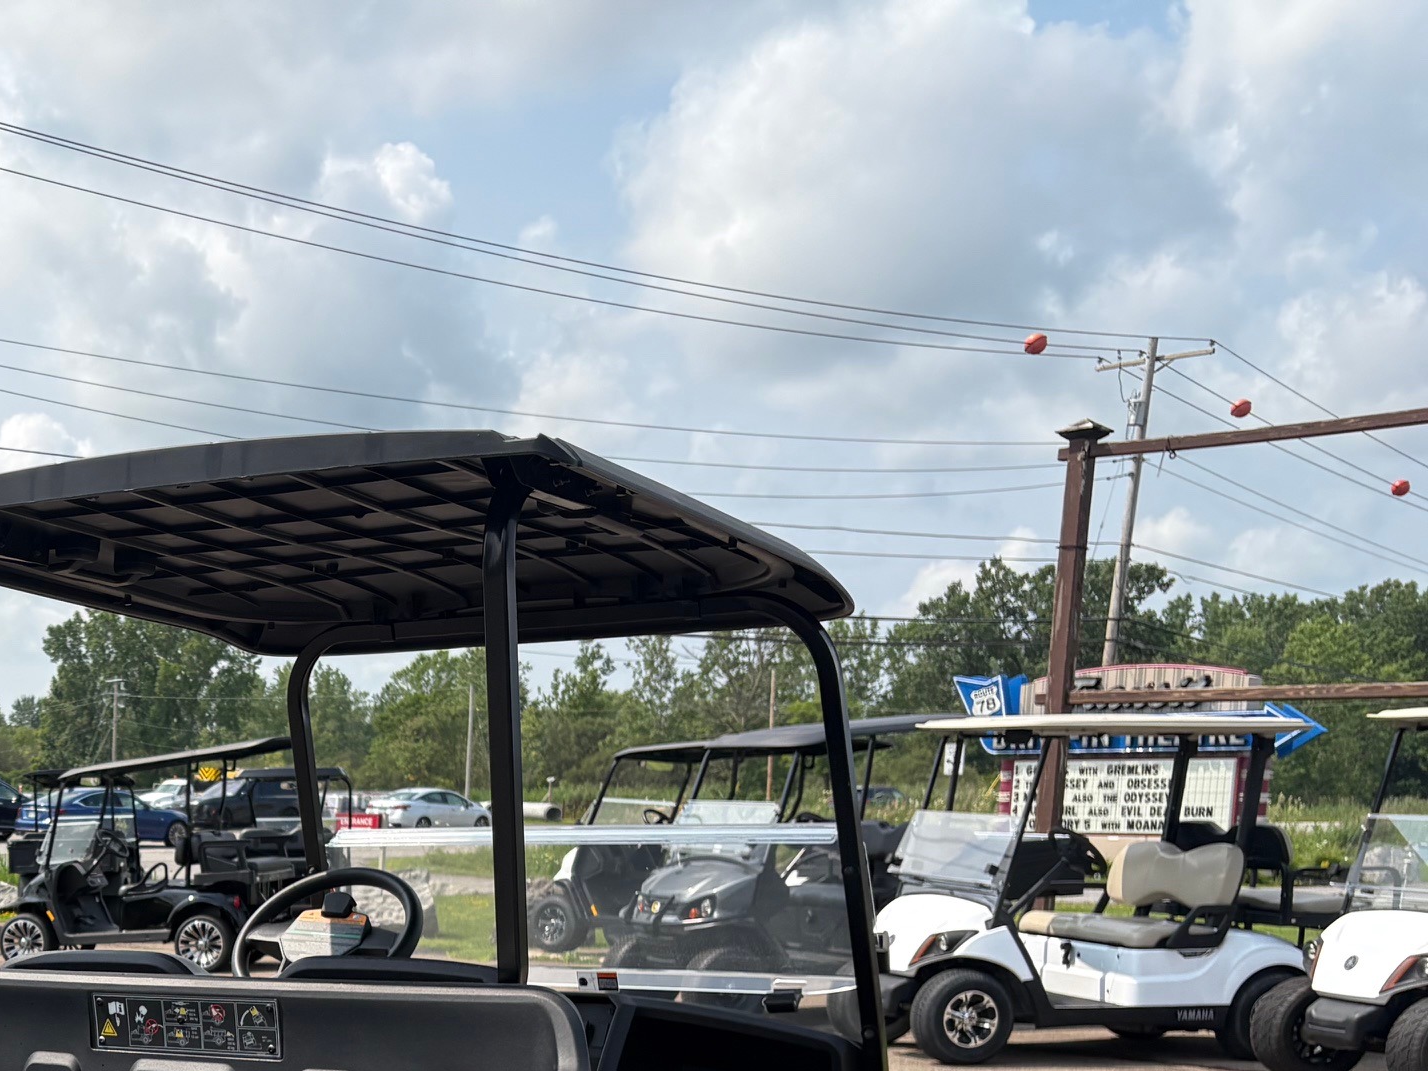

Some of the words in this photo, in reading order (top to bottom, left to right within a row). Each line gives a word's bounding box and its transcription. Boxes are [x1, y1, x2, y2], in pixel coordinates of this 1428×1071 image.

[974, 686, 995, 699] ROUTE
[976, 698, 996, 714] 78
[1078, 766, 1098, 776] WITH
[1106, 764, 1159, 776] GREMLINS
[1014, 779, 1020, 790] 2
[1098, 781, 1115, 789] AND
[1072, 794, 1093, 802] ALSO
[1103, 794, 1118, 803] THE
[1087, 808, 1109, 817] ALSO
[1120, 806, 1143, 817] EVIL
[1183, 806, 1214, 818] BURN
[340, 816, 373, 826] ENRANCE
[1101, 821, 1121, 831] WITH
[1176, 1009, 1214, 1021] YAMAHA
